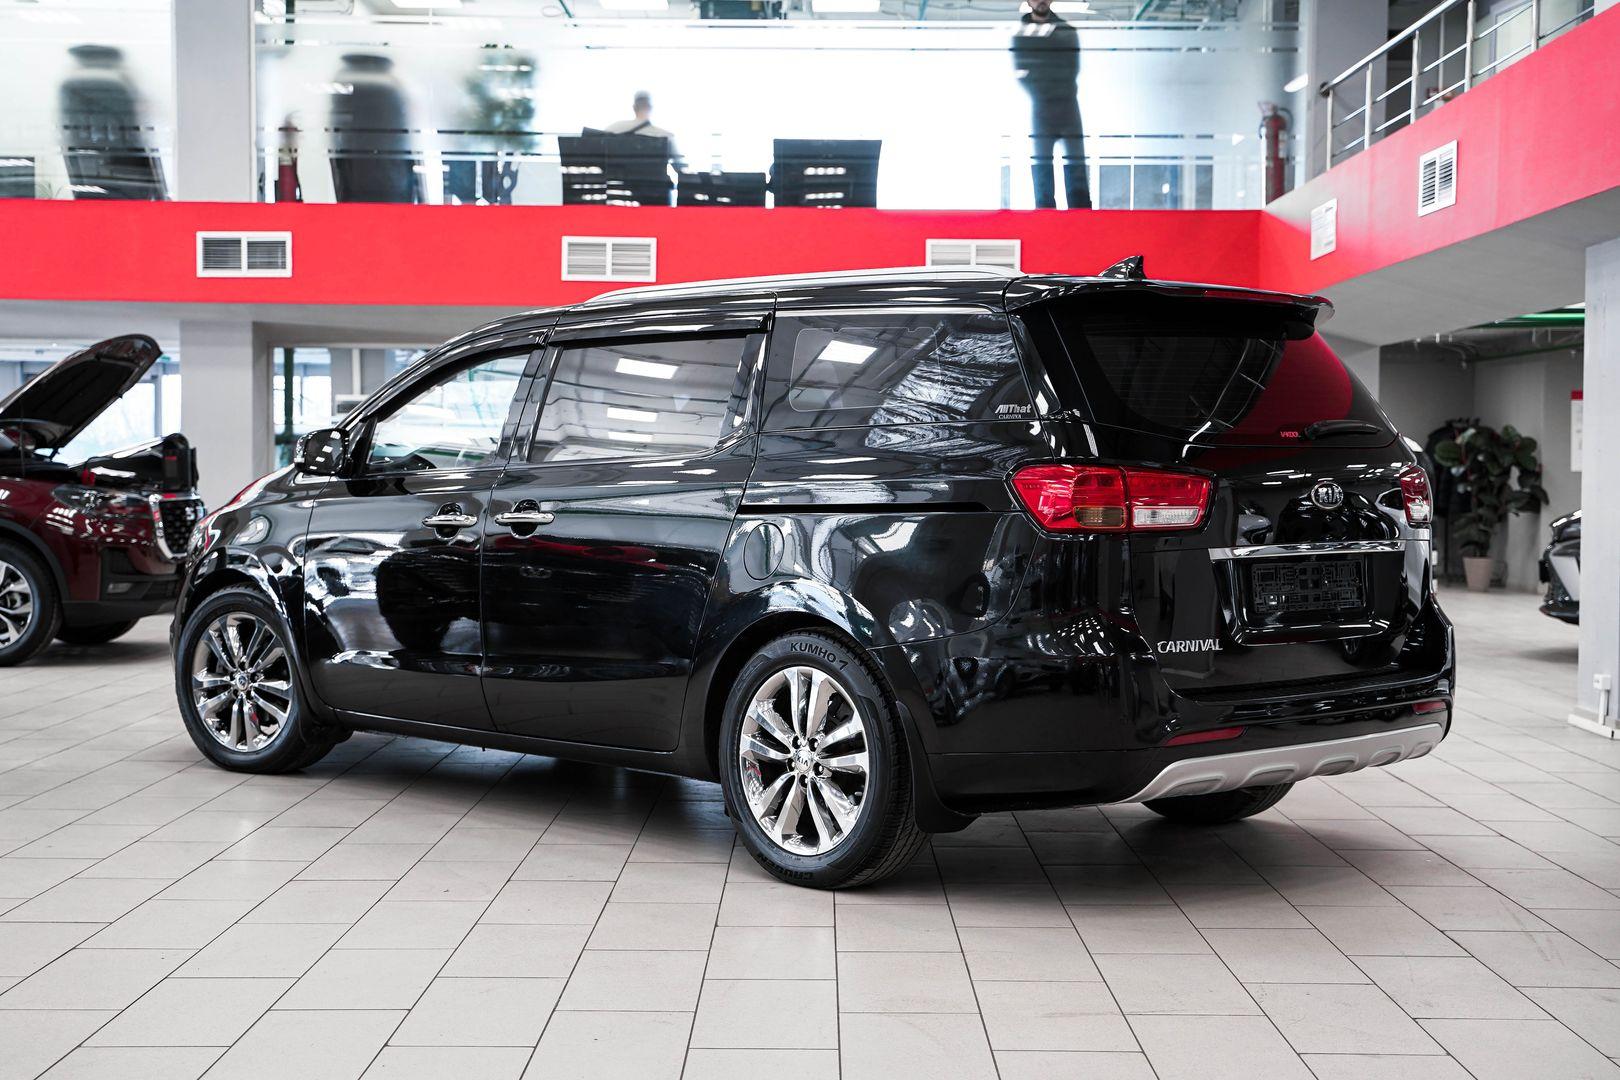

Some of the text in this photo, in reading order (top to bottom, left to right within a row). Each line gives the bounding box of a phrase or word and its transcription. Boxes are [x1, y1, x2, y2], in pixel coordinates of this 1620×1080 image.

[1317, 485, 1342, 503] KIA
[790, 642, 837, 663] KUMHO
[1157, 638, 1223, 653] CARNIVAL
